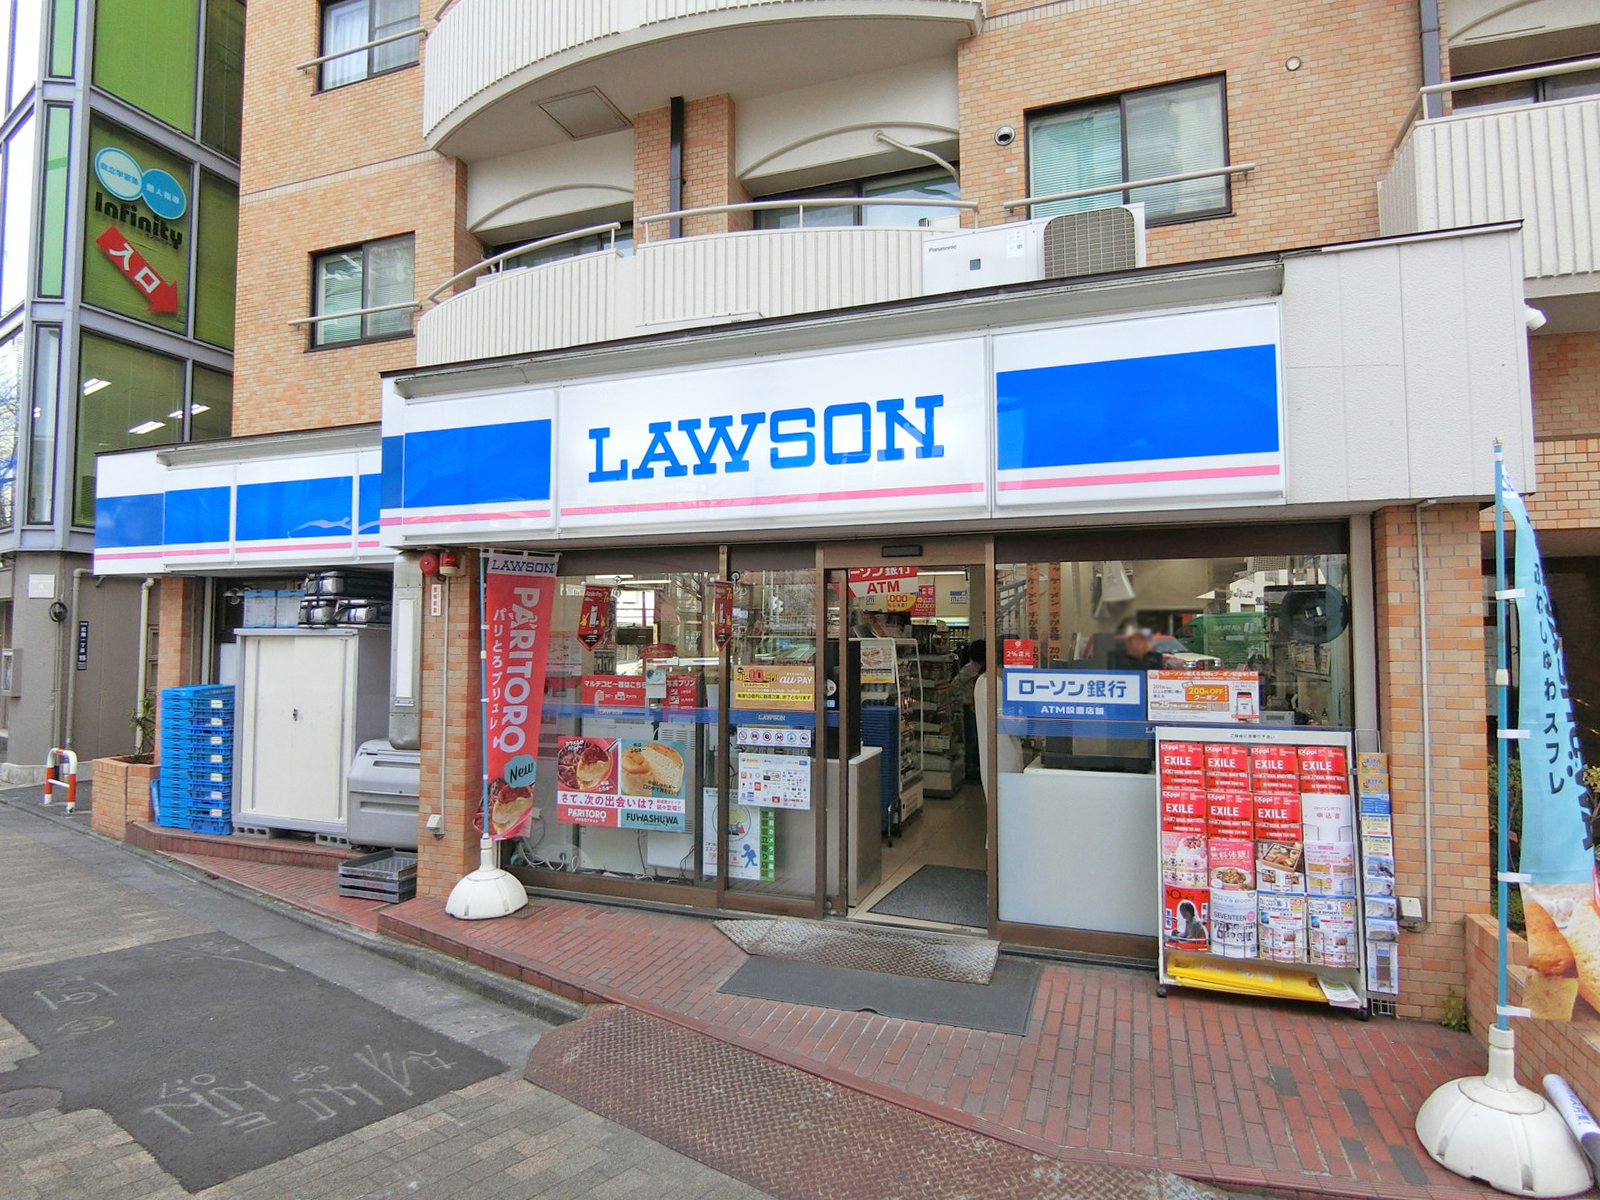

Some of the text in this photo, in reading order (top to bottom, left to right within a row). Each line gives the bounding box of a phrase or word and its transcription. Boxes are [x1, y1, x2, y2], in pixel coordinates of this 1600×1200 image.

[95, 191, 183, 250] Infinity
[928, 244, 957, 252] Panasonic
[109, 242, 161, 294] 入口
[588, 394, 944, 483] LAWSON
[491, 559, 555, 574] LAWSON
[848, 567, 910, 578] ーソン銀行
[866, 580, 900, 594] ATM
[490, 608, 507, 730] パリとろブリュレ
[500, 587, 541, 753] PARITORO
[780, 676, 796, 684] au
[1018, 680, 1127, 698] ローソン銀行
[1164, 755, 1192, 766] EXILE
[1208, 758, 1236, 768] EXILE
[1255, 760, 1283, 769] EXILE
[1302, 761, 1332, 770] EXILE
[510, 762, 534, 784] New
[562, 793, 654, 809] さて、次の出会いは?
[568, 808, 607, 820] PARITORO
[1166, 803, 1194, 814] EXILE
[1211, 806, 1239, 816] EXILE
[1258, 808, 1288, 819] EXILE
[626, 812, 679, 824] FUWASHUWA
[1214, 911, 1246, 921] SEVENTEEN
